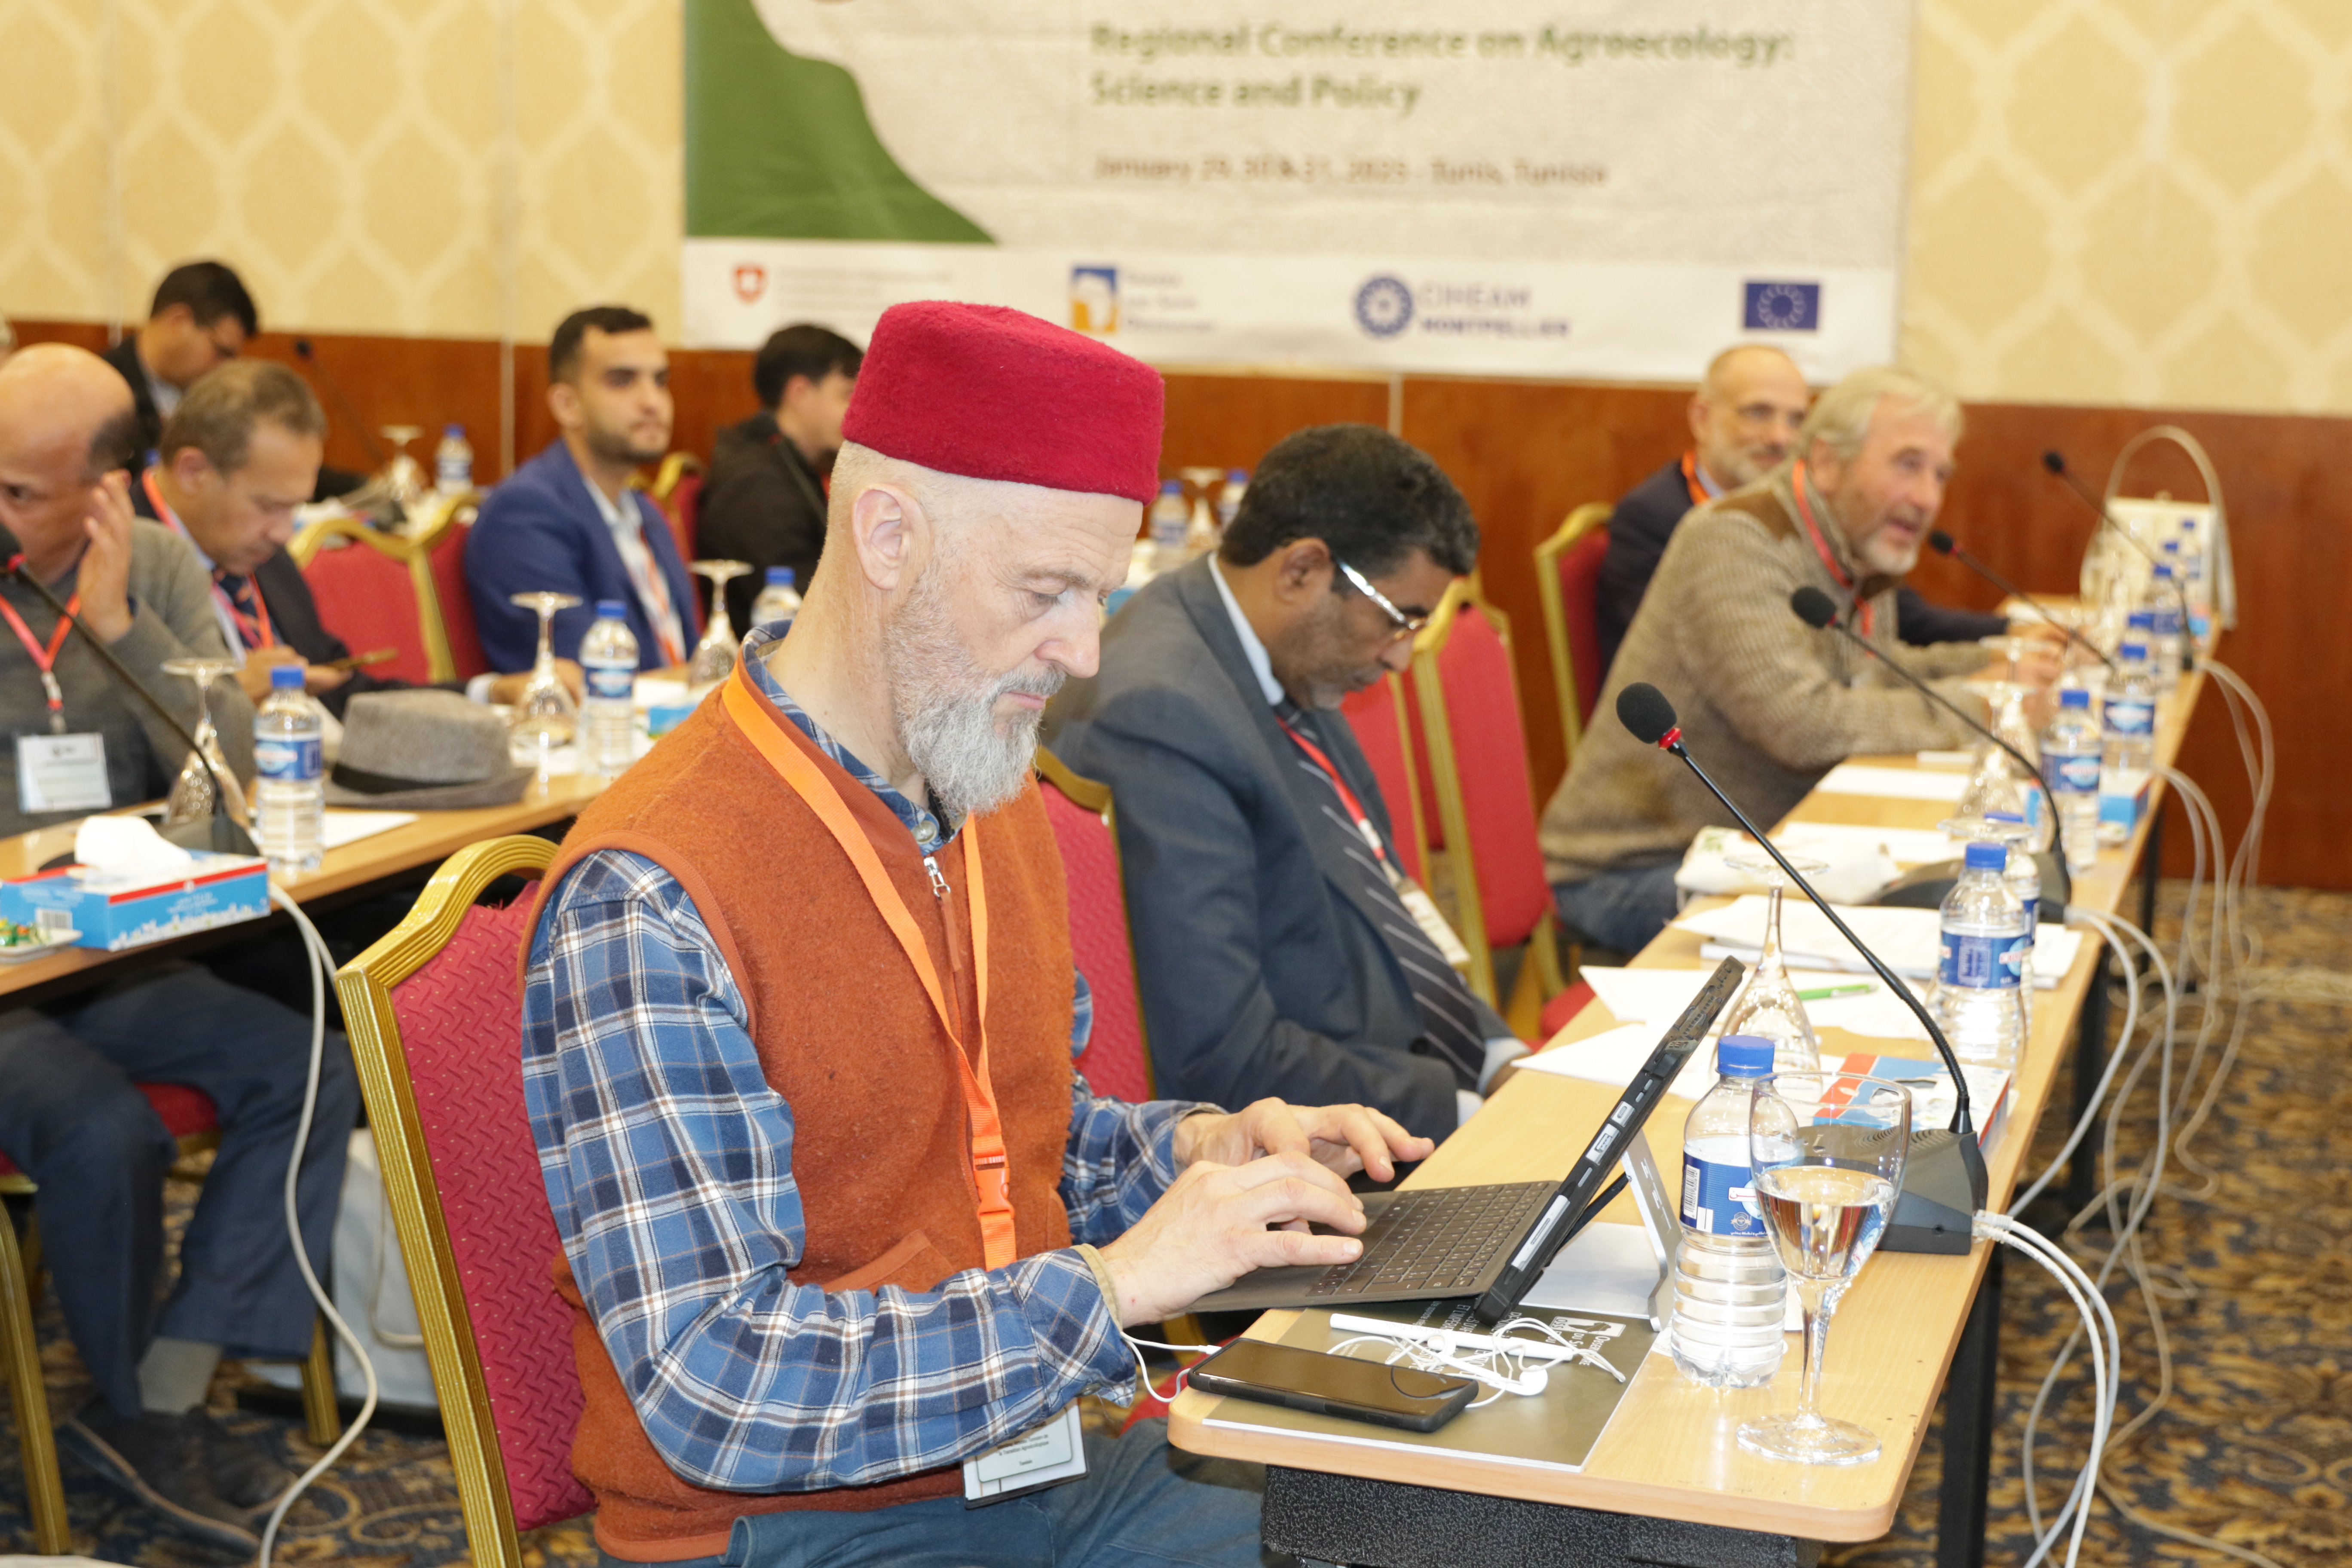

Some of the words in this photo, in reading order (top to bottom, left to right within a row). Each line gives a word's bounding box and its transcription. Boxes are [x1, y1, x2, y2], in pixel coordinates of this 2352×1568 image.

[1092, 22, 1250, 64] Regional
[1258, 21, 1466, 58] Conference
[1476, 33, 1525, 58] on
[1535, 24, 1794, 68] Agroecology:
[1091, 70, 1224, 107] Science
[1231, 70, 1301, 107] and
[1311, 72, 1420, 116] Policy
[1094, 156, 1191, 184] January
[1514, 158, 1609, 185] Tunisia
[1423, 317, 1570, 339] MONTPELLIER
[1552, 1318, 1568, 1329] OSS
